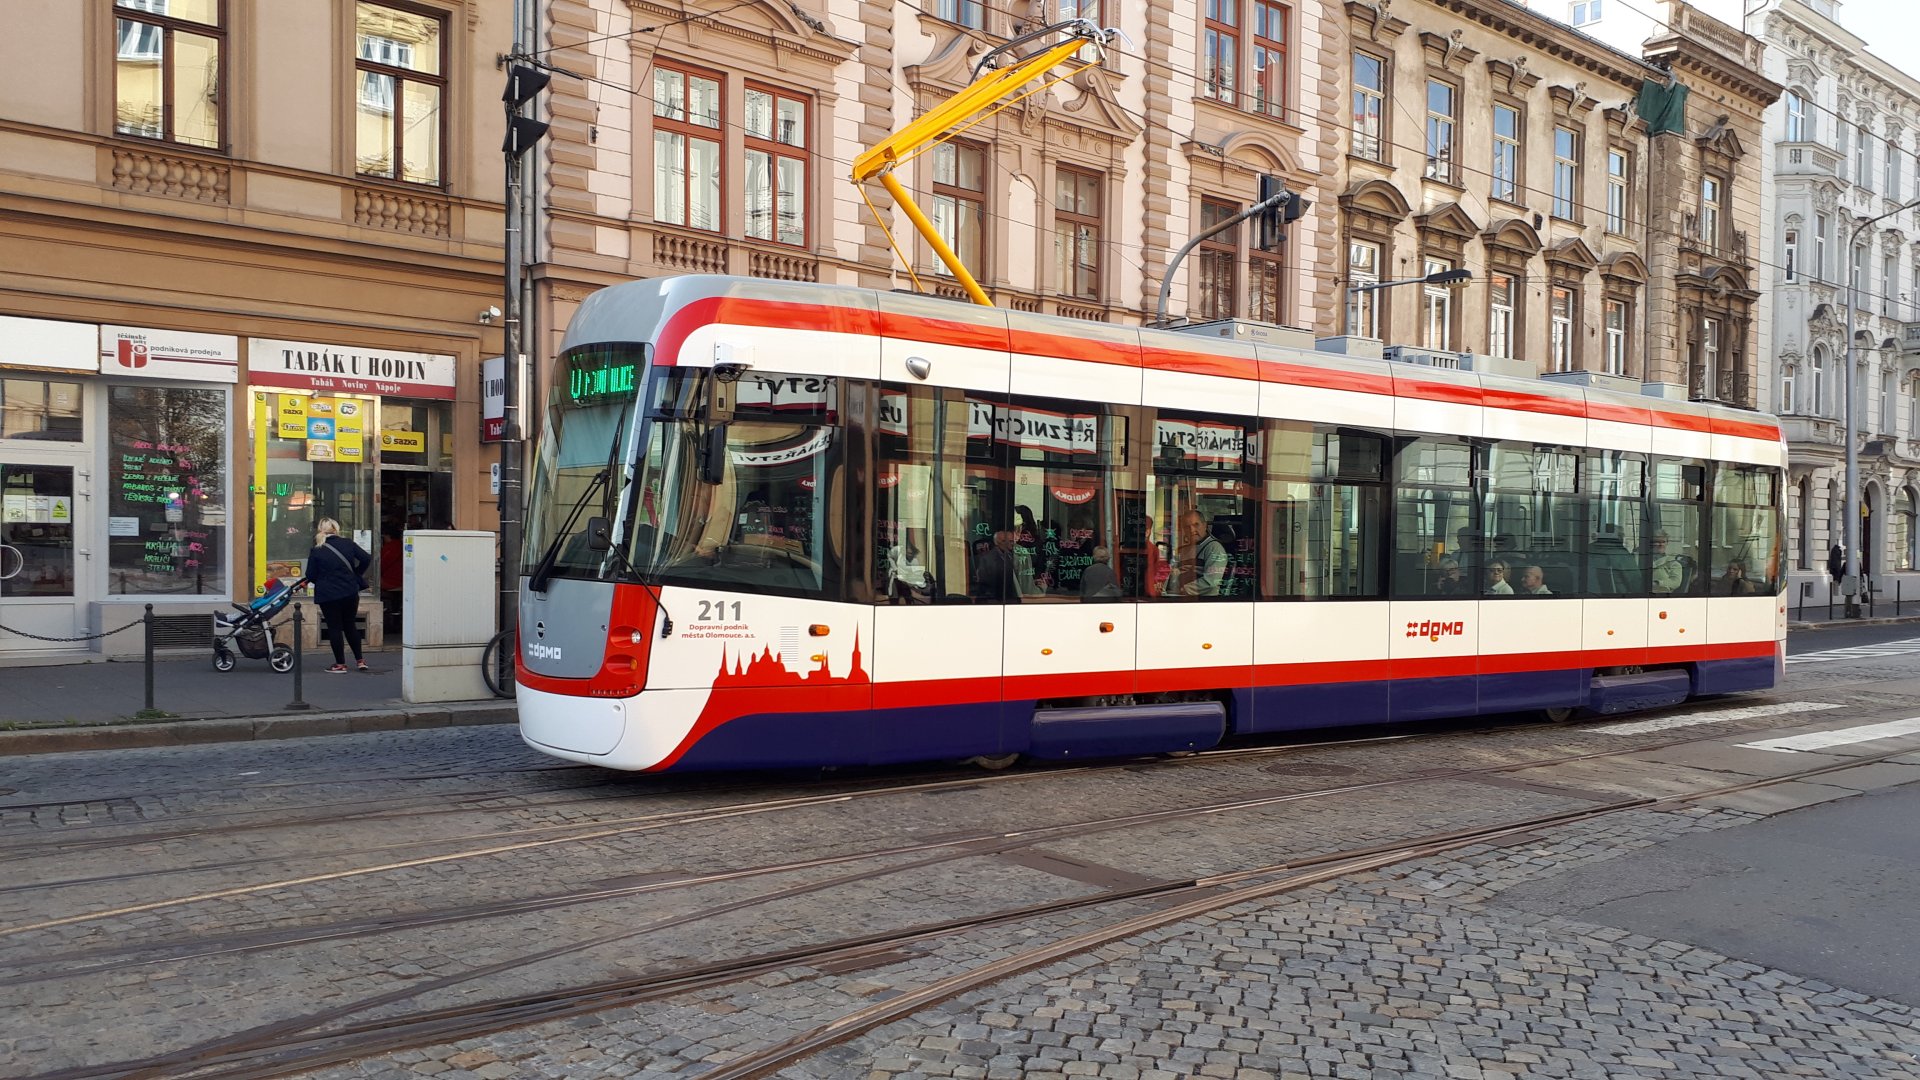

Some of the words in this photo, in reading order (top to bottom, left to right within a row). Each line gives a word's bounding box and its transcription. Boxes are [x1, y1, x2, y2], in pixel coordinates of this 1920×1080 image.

[150, 346, 189, 354] podniková
[190, 348, 222, 357] prodejna
[282, 348, 345, 374] TABÁK
[351, 355, 362, 375] U
[368, 357, 426, 380] HODIN
[310, 377, 334, 387] Tabák
[342, 379, 368, 391] Noviny
[376, 382, 401, 393] Nápoje
[393, 438, 418, 446] sazka
[698, 600, 741, 621] 211
